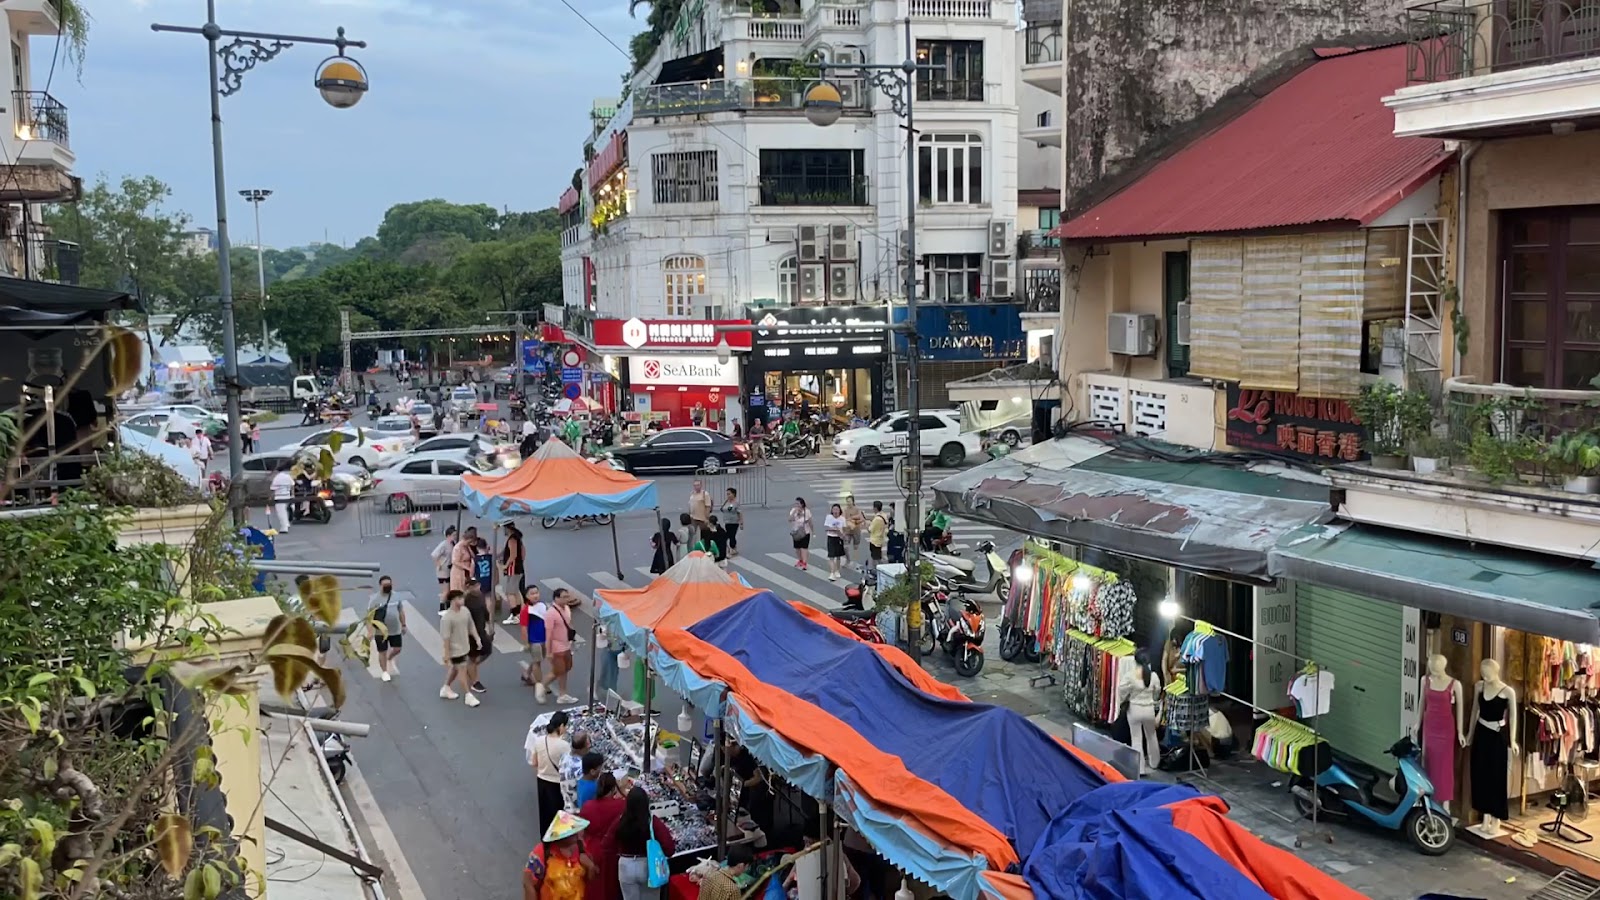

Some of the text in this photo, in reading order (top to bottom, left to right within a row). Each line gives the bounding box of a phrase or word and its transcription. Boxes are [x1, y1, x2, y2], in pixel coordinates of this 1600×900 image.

[929, 335, 992, 349] DIAMOND
[663, 364, 722, 377] SeABank
[1274, 391, 1315, 418] HONG
[1276, 423, 1360, 461] 映丽香港
[1261, 604, 1290, 625] BUÔN
[1454, 631, 1466, 643] 98
